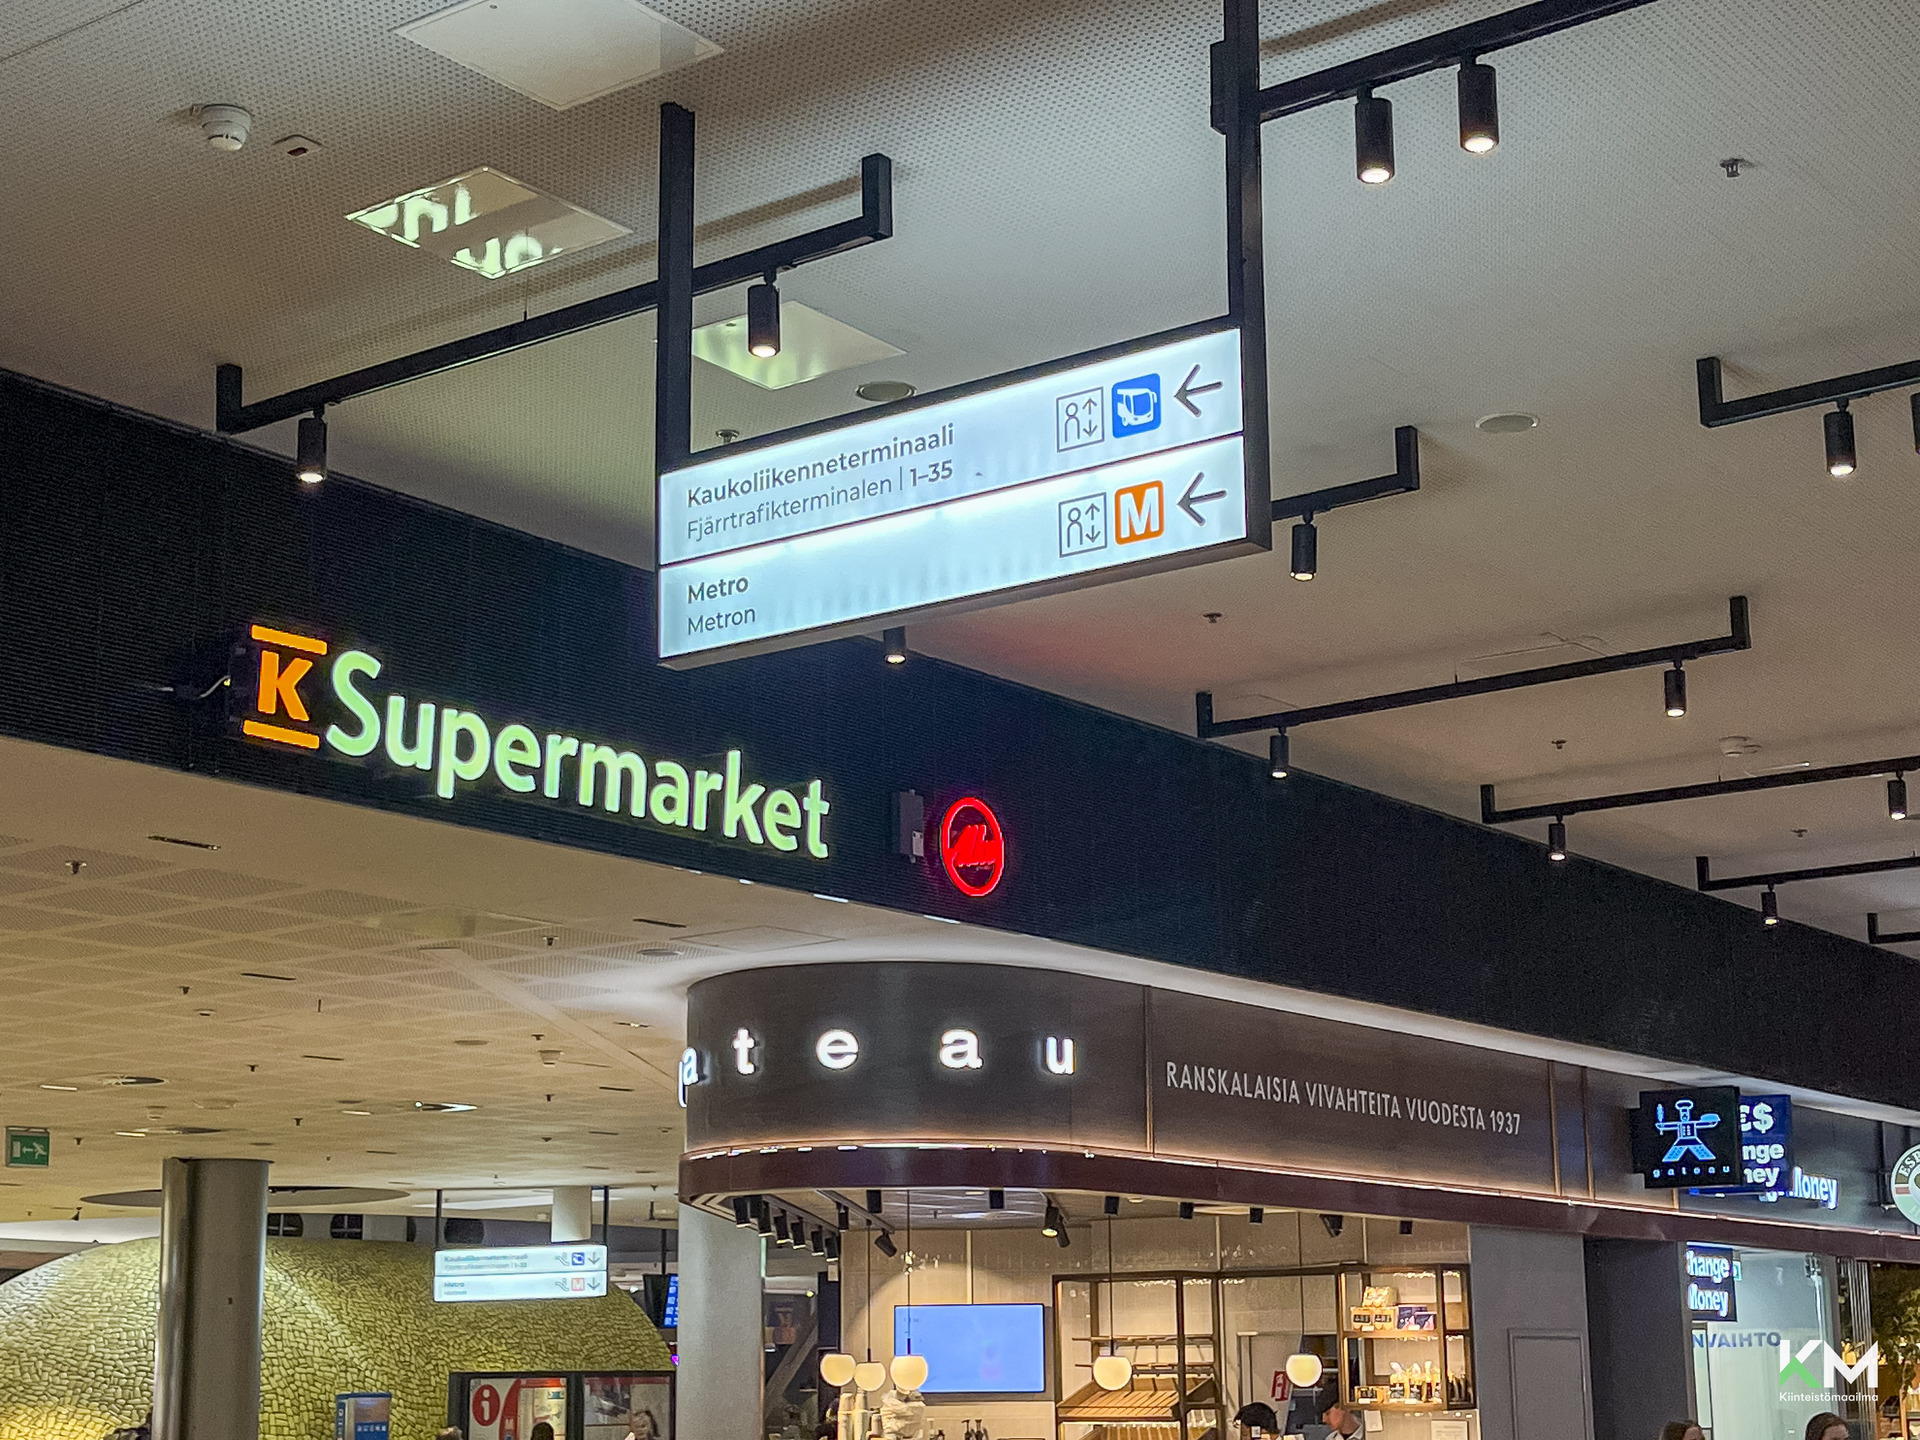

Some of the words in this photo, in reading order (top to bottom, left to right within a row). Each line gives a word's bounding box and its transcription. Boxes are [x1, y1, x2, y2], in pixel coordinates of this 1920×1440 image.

[687, 423, 955, 507] Kaukoliikenneterminaali
[687, 477, 893, 541] Fjärrtrafikterminalen
[687, 574, 749, 604] Metro
[687, 606, 756, 636] Metron
[256, 651, 313, 722] K
[326, 650, 830, 858] Supermarket
[1166, 1061, 1300, 1104] RANSKALAISIA
[1305, 1081, 1401, 1118] VIVAHTEITA
[1406, 1097, 1486, 1131] VUODESTA
[1489, 1109, 1521, 1135] 1937
